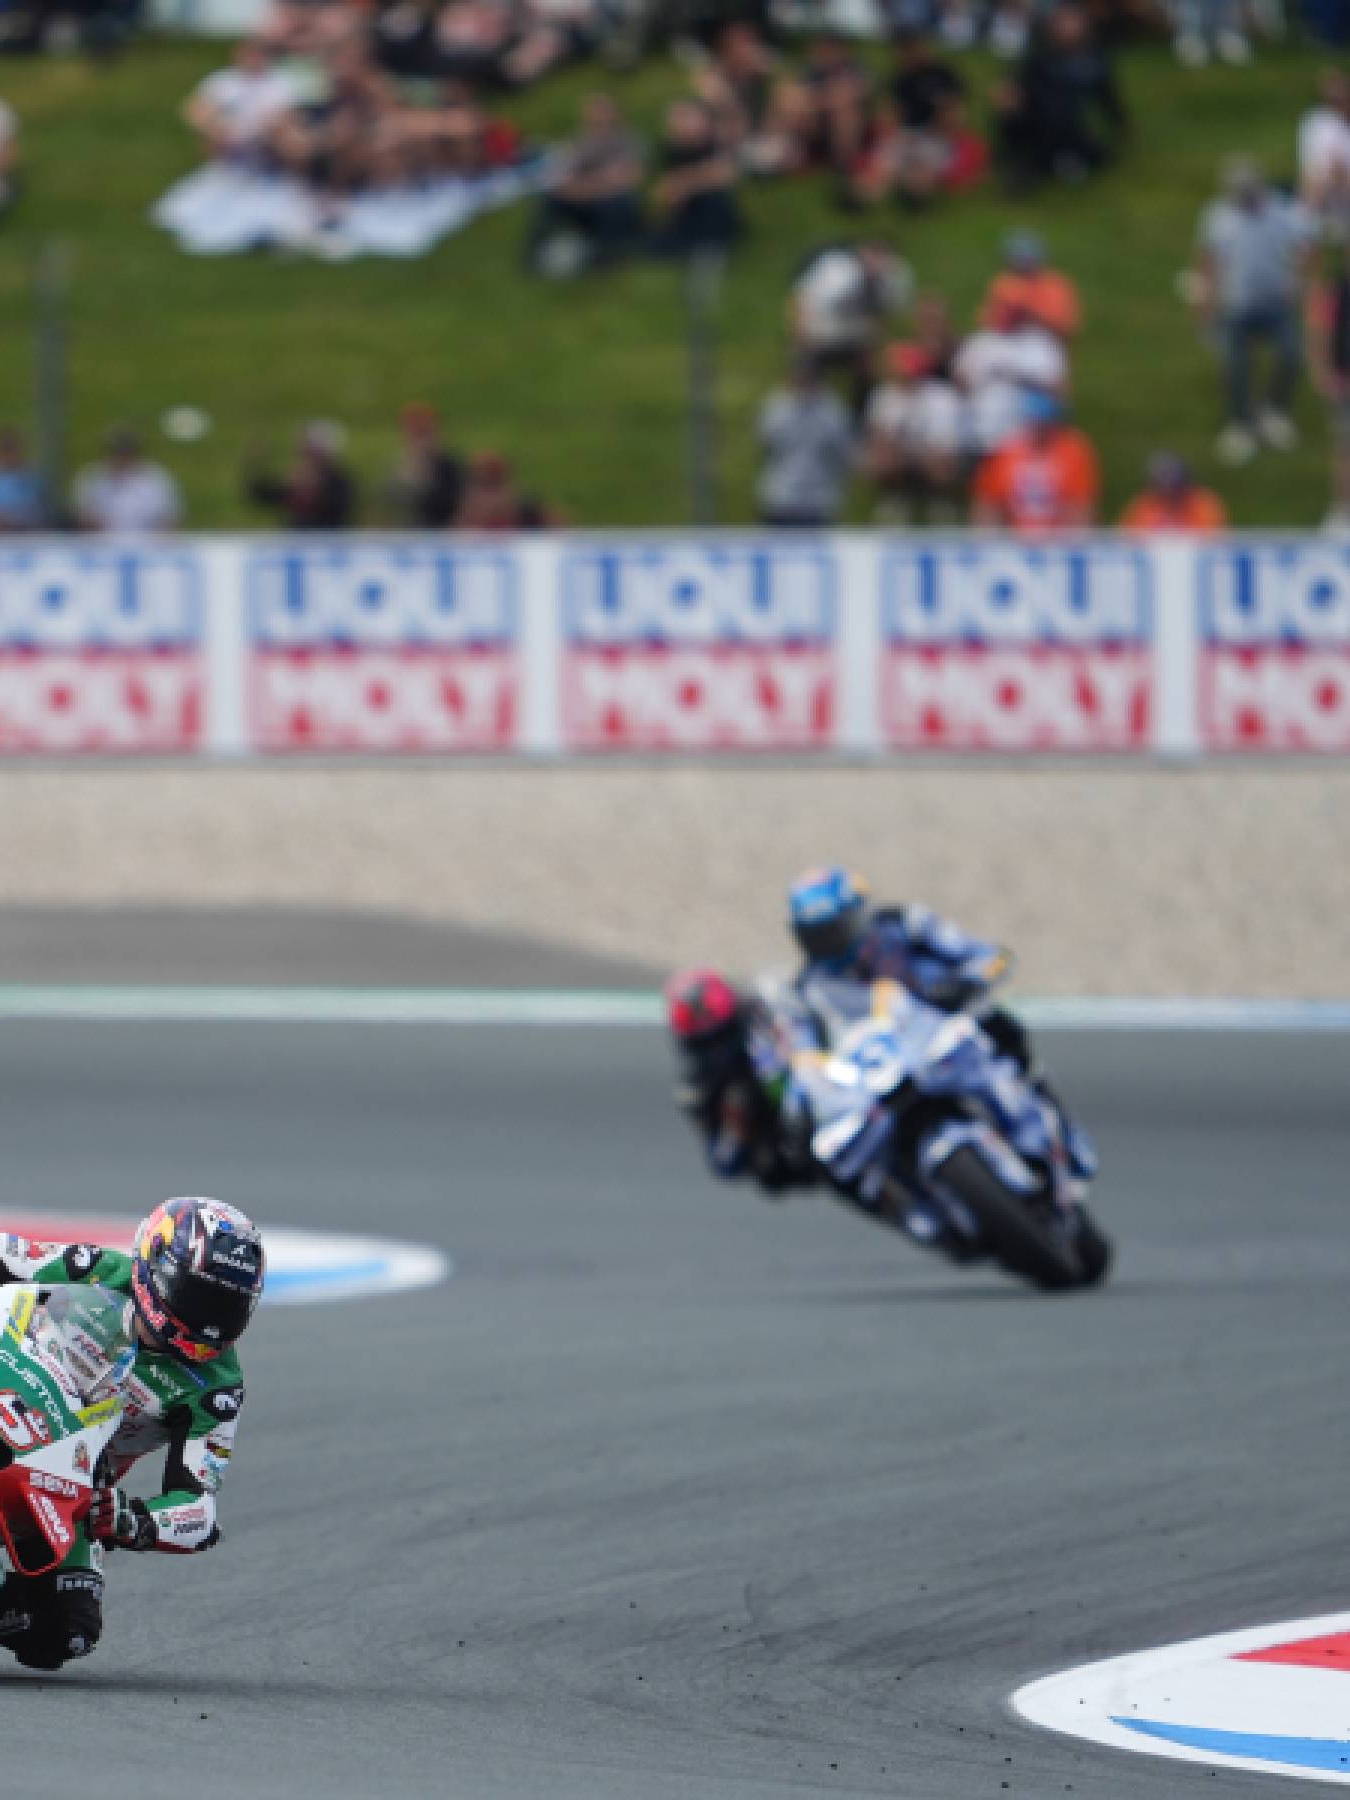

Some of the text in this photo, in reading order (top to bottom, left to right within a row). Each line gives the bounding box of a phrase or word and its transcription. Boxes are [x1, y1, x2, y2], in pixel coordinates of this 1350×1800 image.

[262, 552, 507, 640] LIQUI
[574, 552, 822, 640] LIQUI
[896, 552, 1139, 640] LIQUI
[264, 652, 516, 740] MOLY
[576, 652, 831, 740] MOLY
[898, 652, 1148, 740] MOLY
